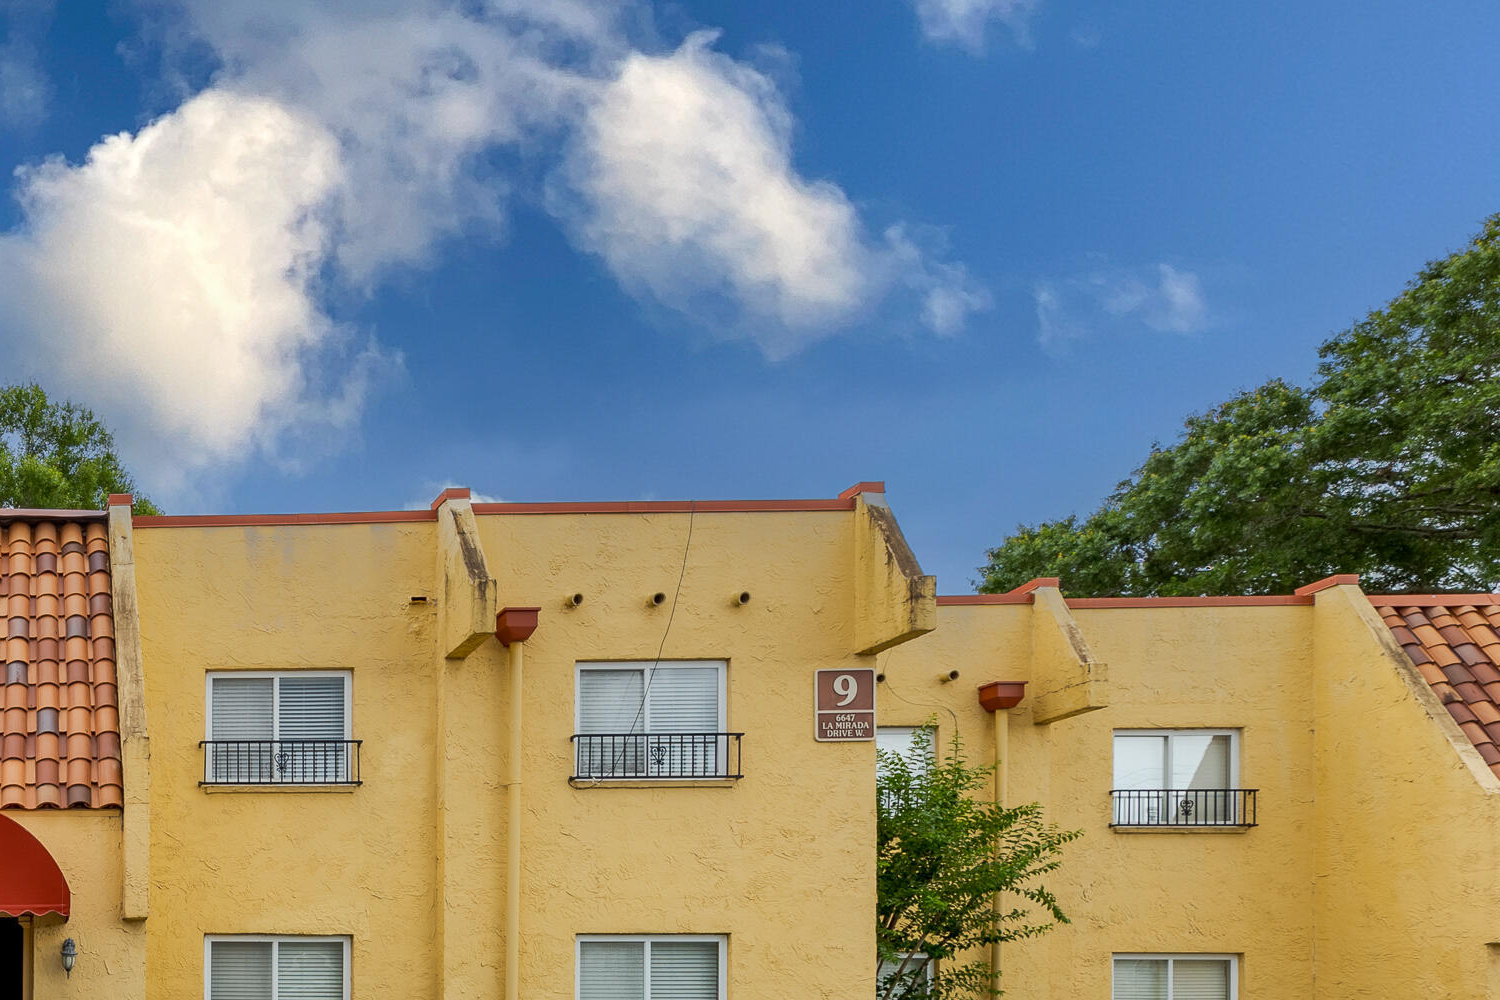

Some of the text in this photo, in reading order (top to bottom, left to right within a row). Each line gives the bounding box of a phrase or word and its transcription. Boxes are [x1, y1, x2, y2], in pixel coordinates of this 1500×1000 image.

[833, 674, 858, 707] 9
[835, 714, 856, 722] 6647
[822, 721, 870, 730] LA MIRADA
[827, 729, 865, 737] DRIVE W.
